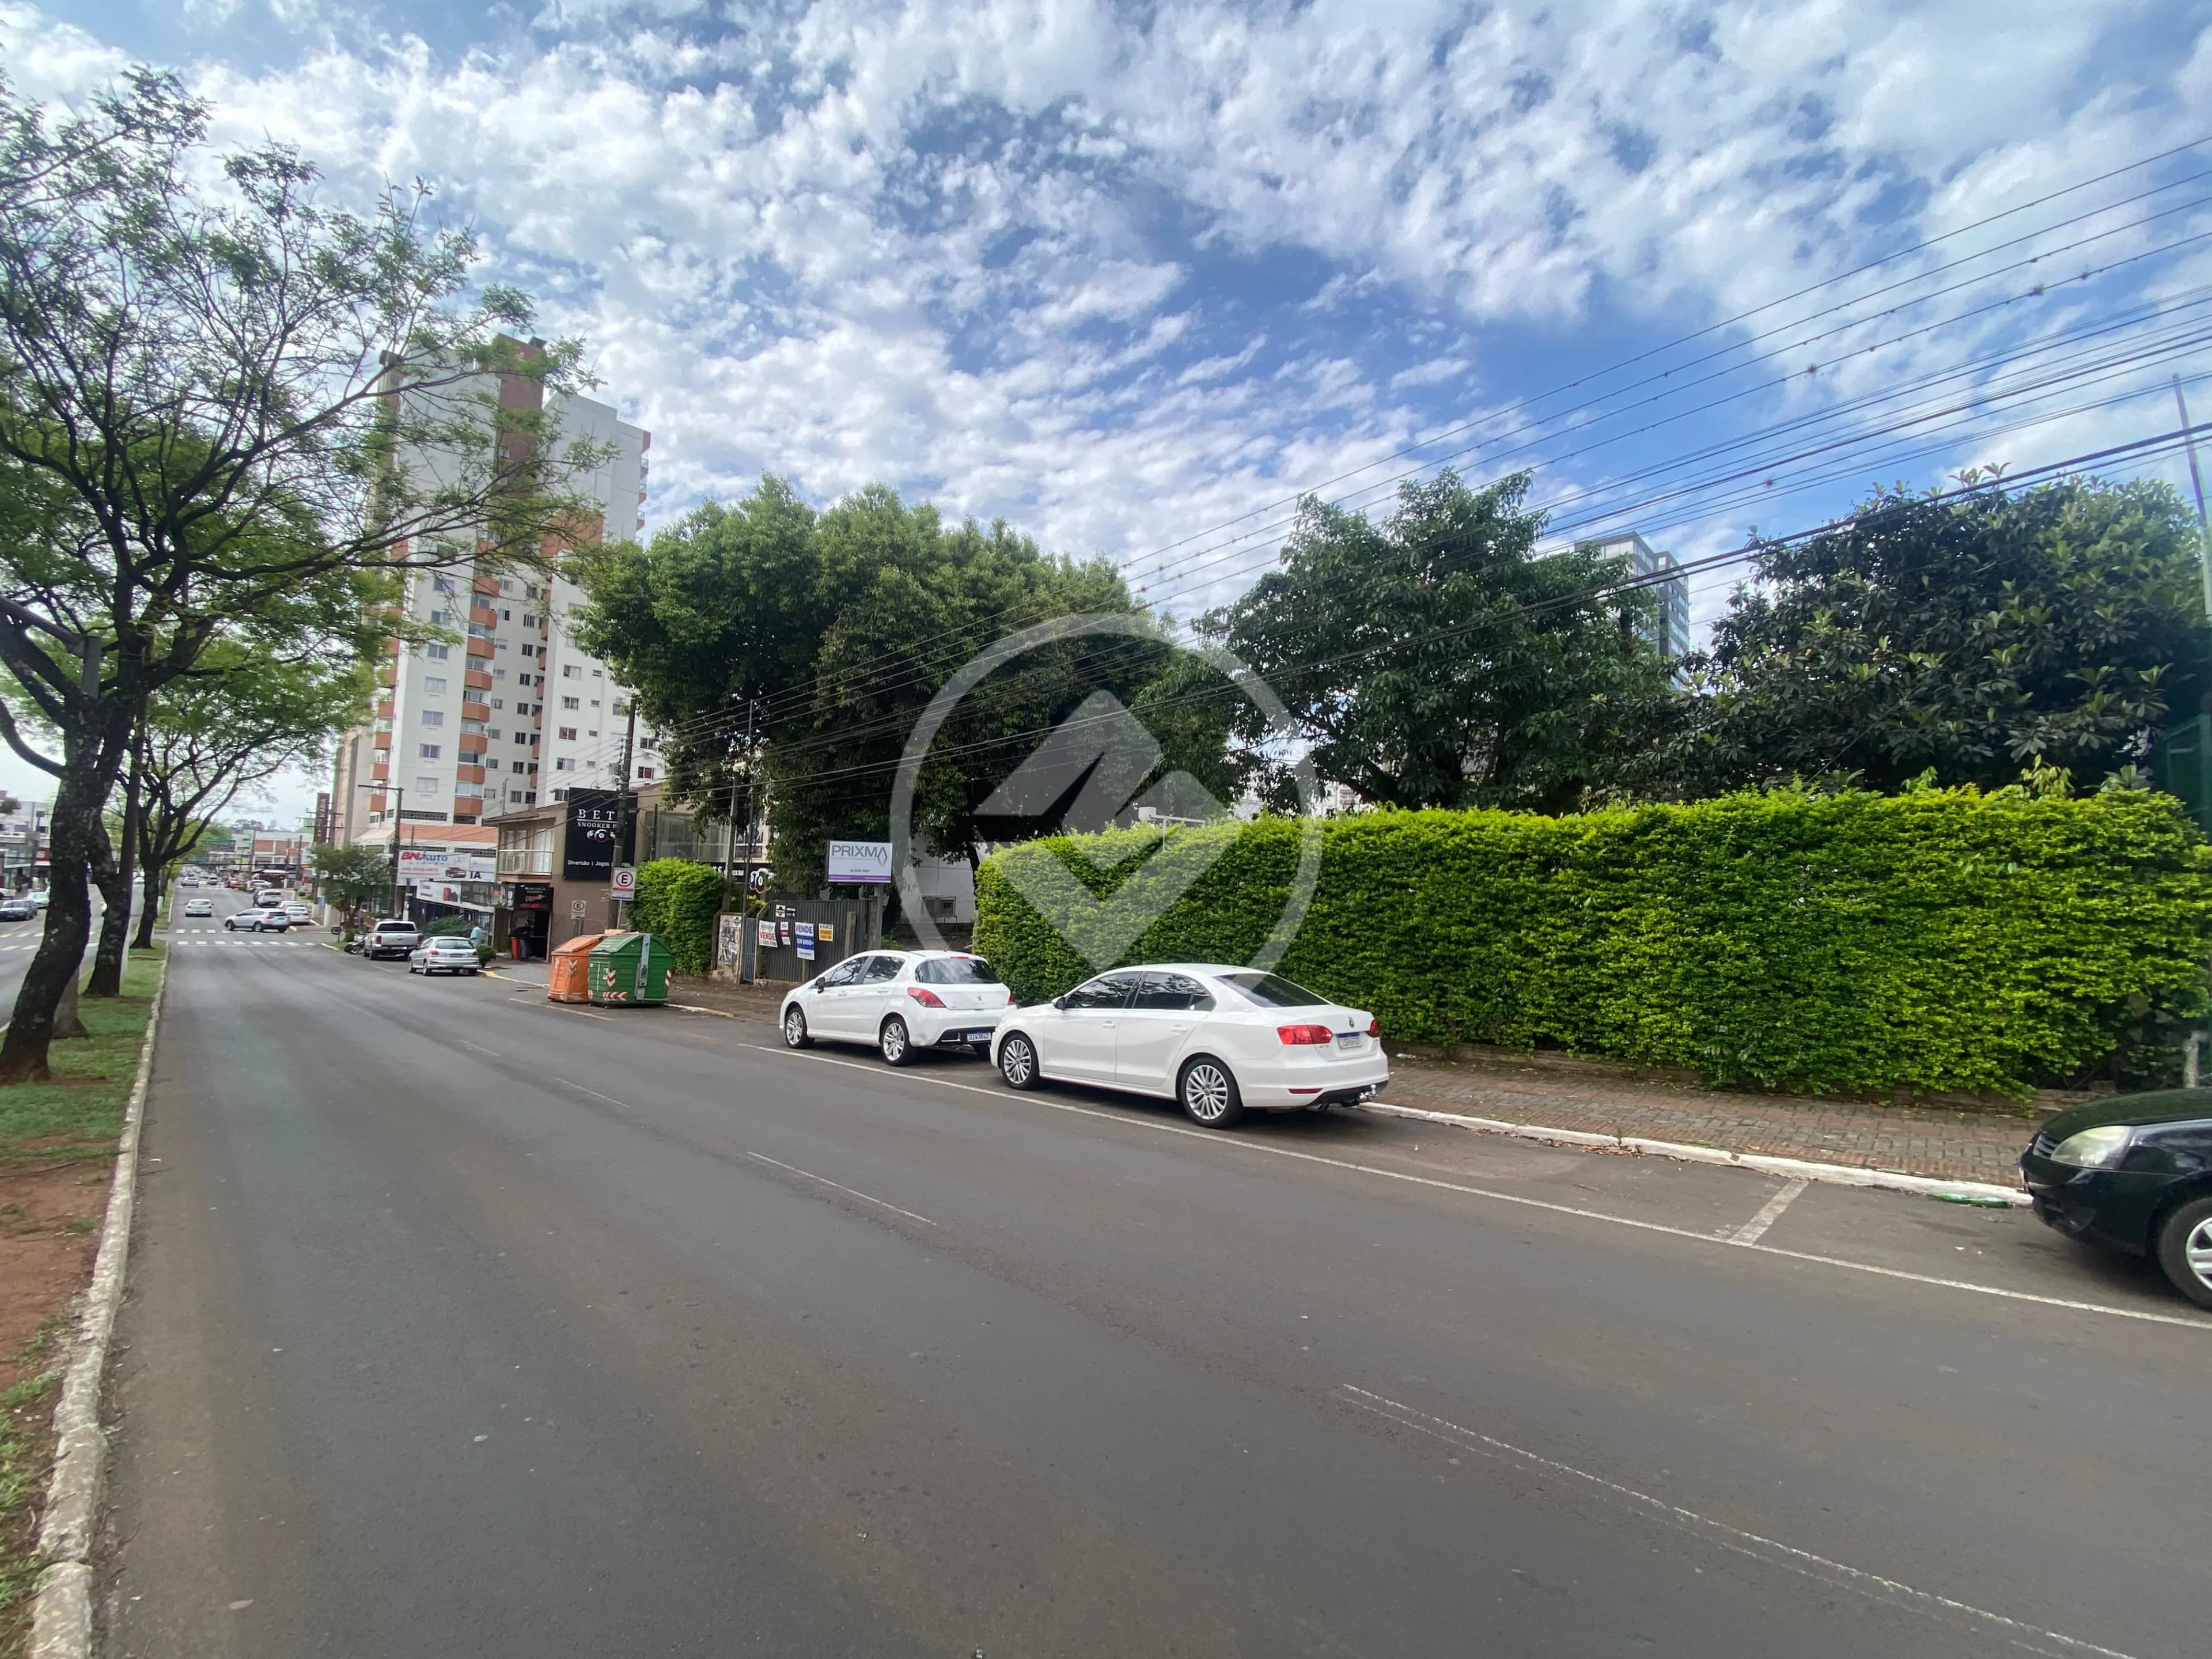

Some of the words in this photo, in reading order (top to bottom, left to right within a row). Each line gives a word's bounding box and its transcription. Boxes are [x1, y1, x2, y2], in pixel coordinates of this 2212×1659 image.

[622, 874, 628, 884] E
[796, 925, 812, 933] VENDE
[760, 931, 775, 941] VENDE
